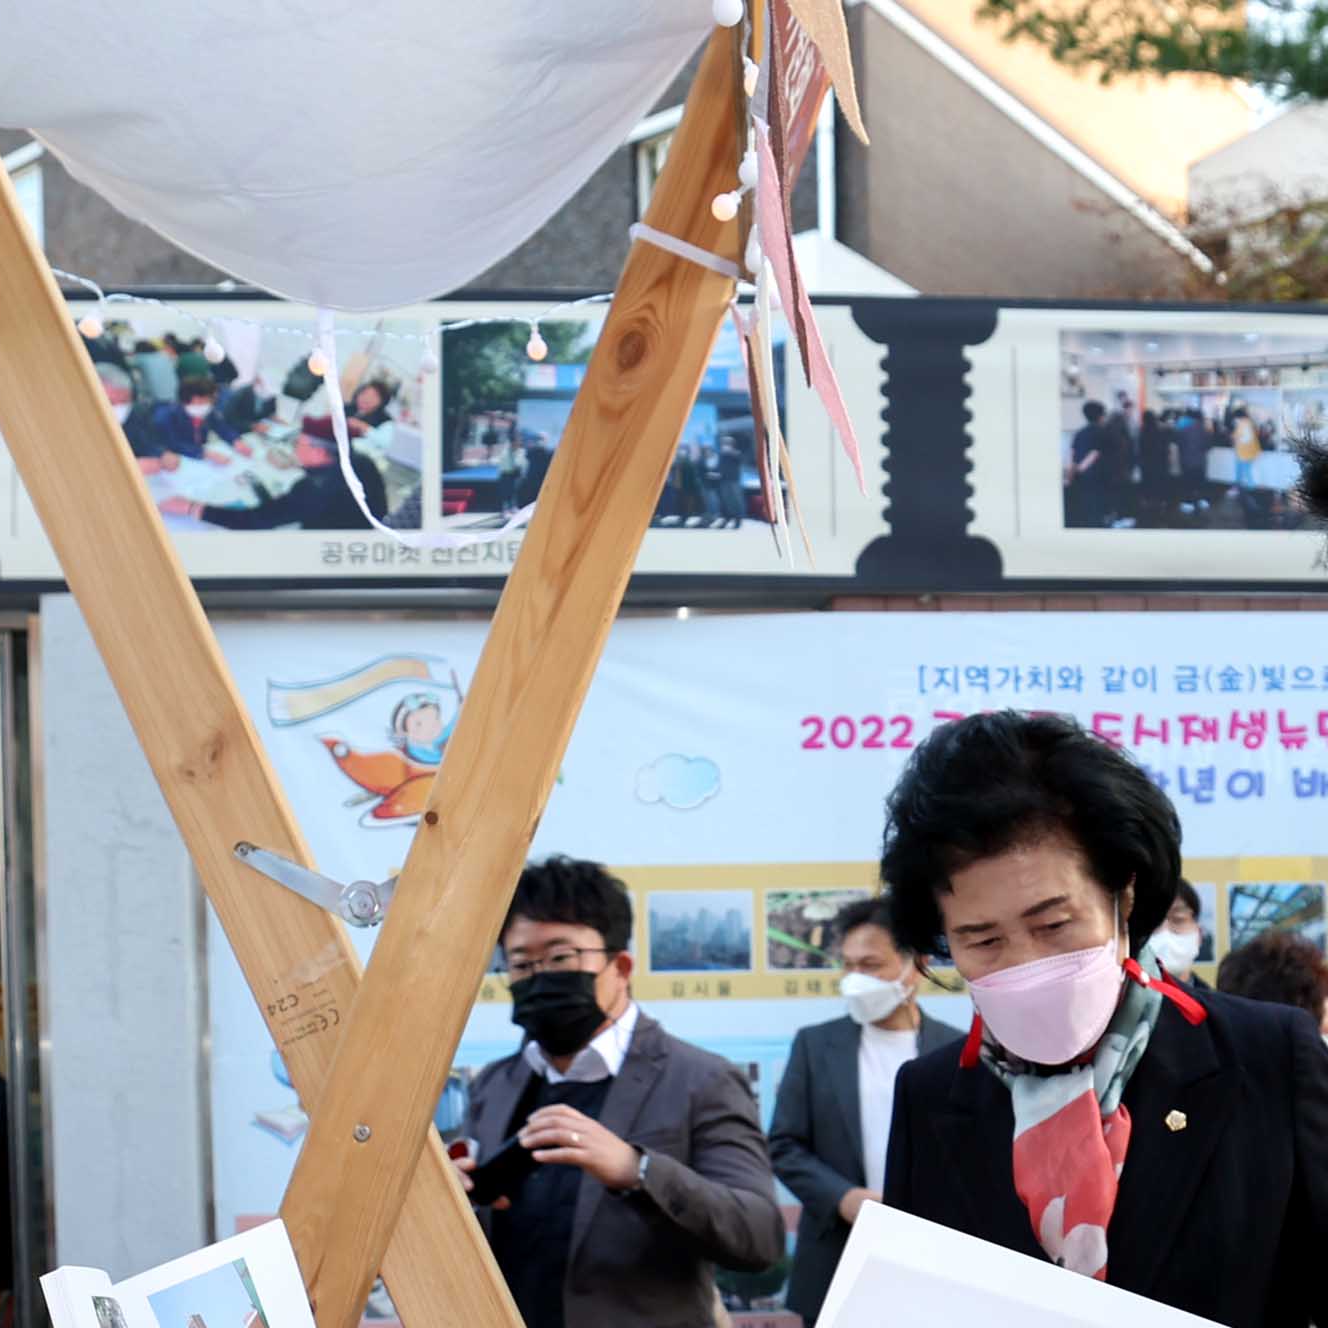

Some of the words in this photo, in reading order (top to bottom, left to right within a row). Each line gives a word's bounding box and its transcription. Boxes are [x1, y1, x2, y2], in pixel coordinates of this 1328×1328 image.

[917, 665, 1084, 693] [지역가치와
[1102, 665, 1158, 693] 같이
[800, 714, 914, 751] 2022
